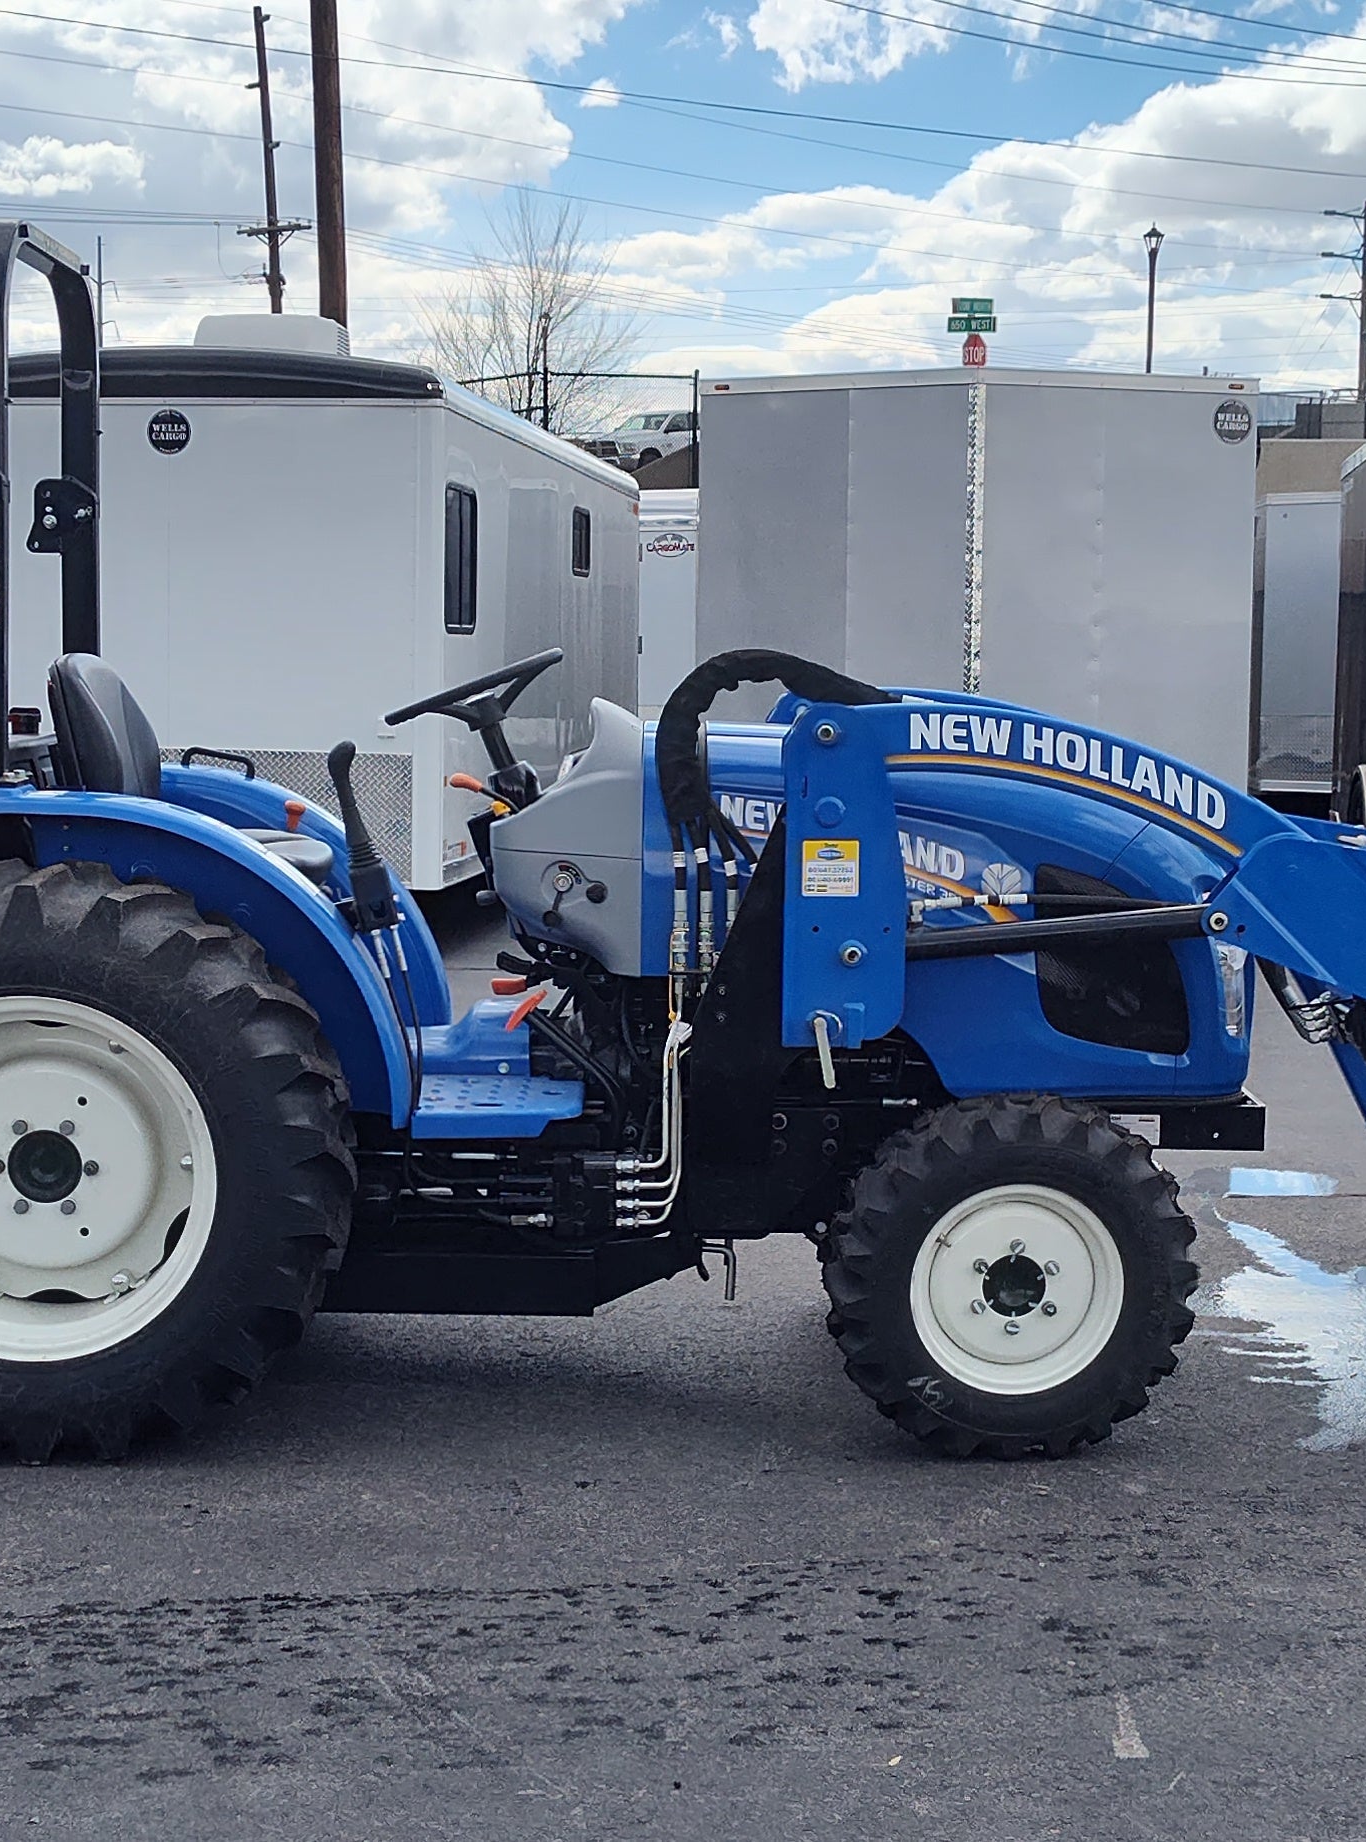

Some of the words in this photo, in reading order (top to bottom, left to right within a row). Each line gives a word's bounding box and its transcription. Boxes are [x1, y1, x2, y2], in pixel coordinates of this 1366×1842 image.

[950, 320, 966, 330] 650
[970, 319, 991, 330] WEST
[964, 346, 984, 363] STOP
[1217, 412, 1249, 422] WELLS
[152, 423, 187, 432] WELLS
[1216, 421, 1249, 431] CARGO
[152, 431, 187, 441] CARGO
[910, 713, 1012, 756] NEW
[1023, 722, 1226, 830] HOLLAND
